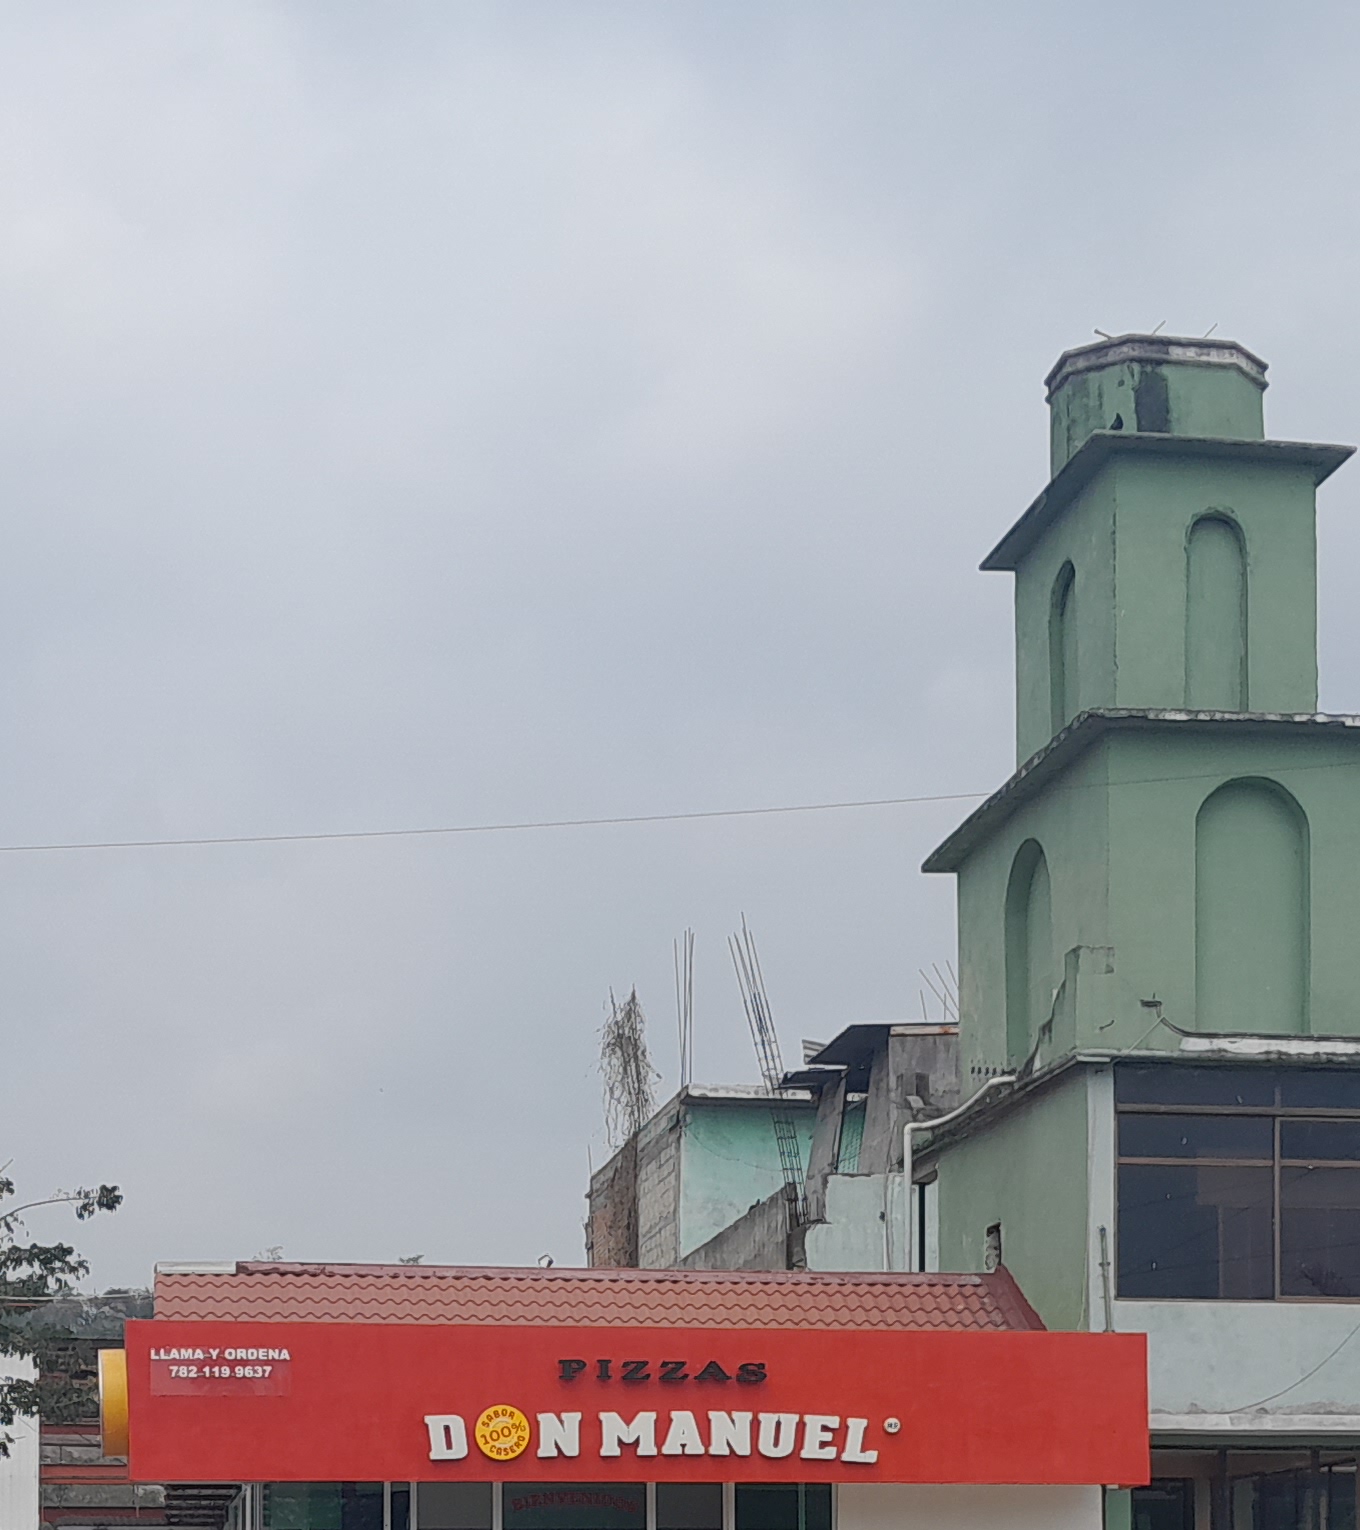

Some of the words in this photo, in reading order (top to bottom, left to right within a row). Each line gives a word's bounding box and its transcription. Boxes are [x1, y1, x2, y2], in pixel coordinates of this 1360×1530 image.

[150, 1348, 204, 1360] LLAMA
[209, 1348, 220, 1360] Y
[224, 1348, 290, 1361] ORDENA
[235, 1366, 273, 1378] 9637
[558, 1359, 768, 1384] PIZZAS
[481, 1408, 516, 1428] SABOR
[480, 1420, 527, 1446] 100%
[598, 1410, 879, 1464] MANUEL
[488, 1434, 526, 1457] CASERO
